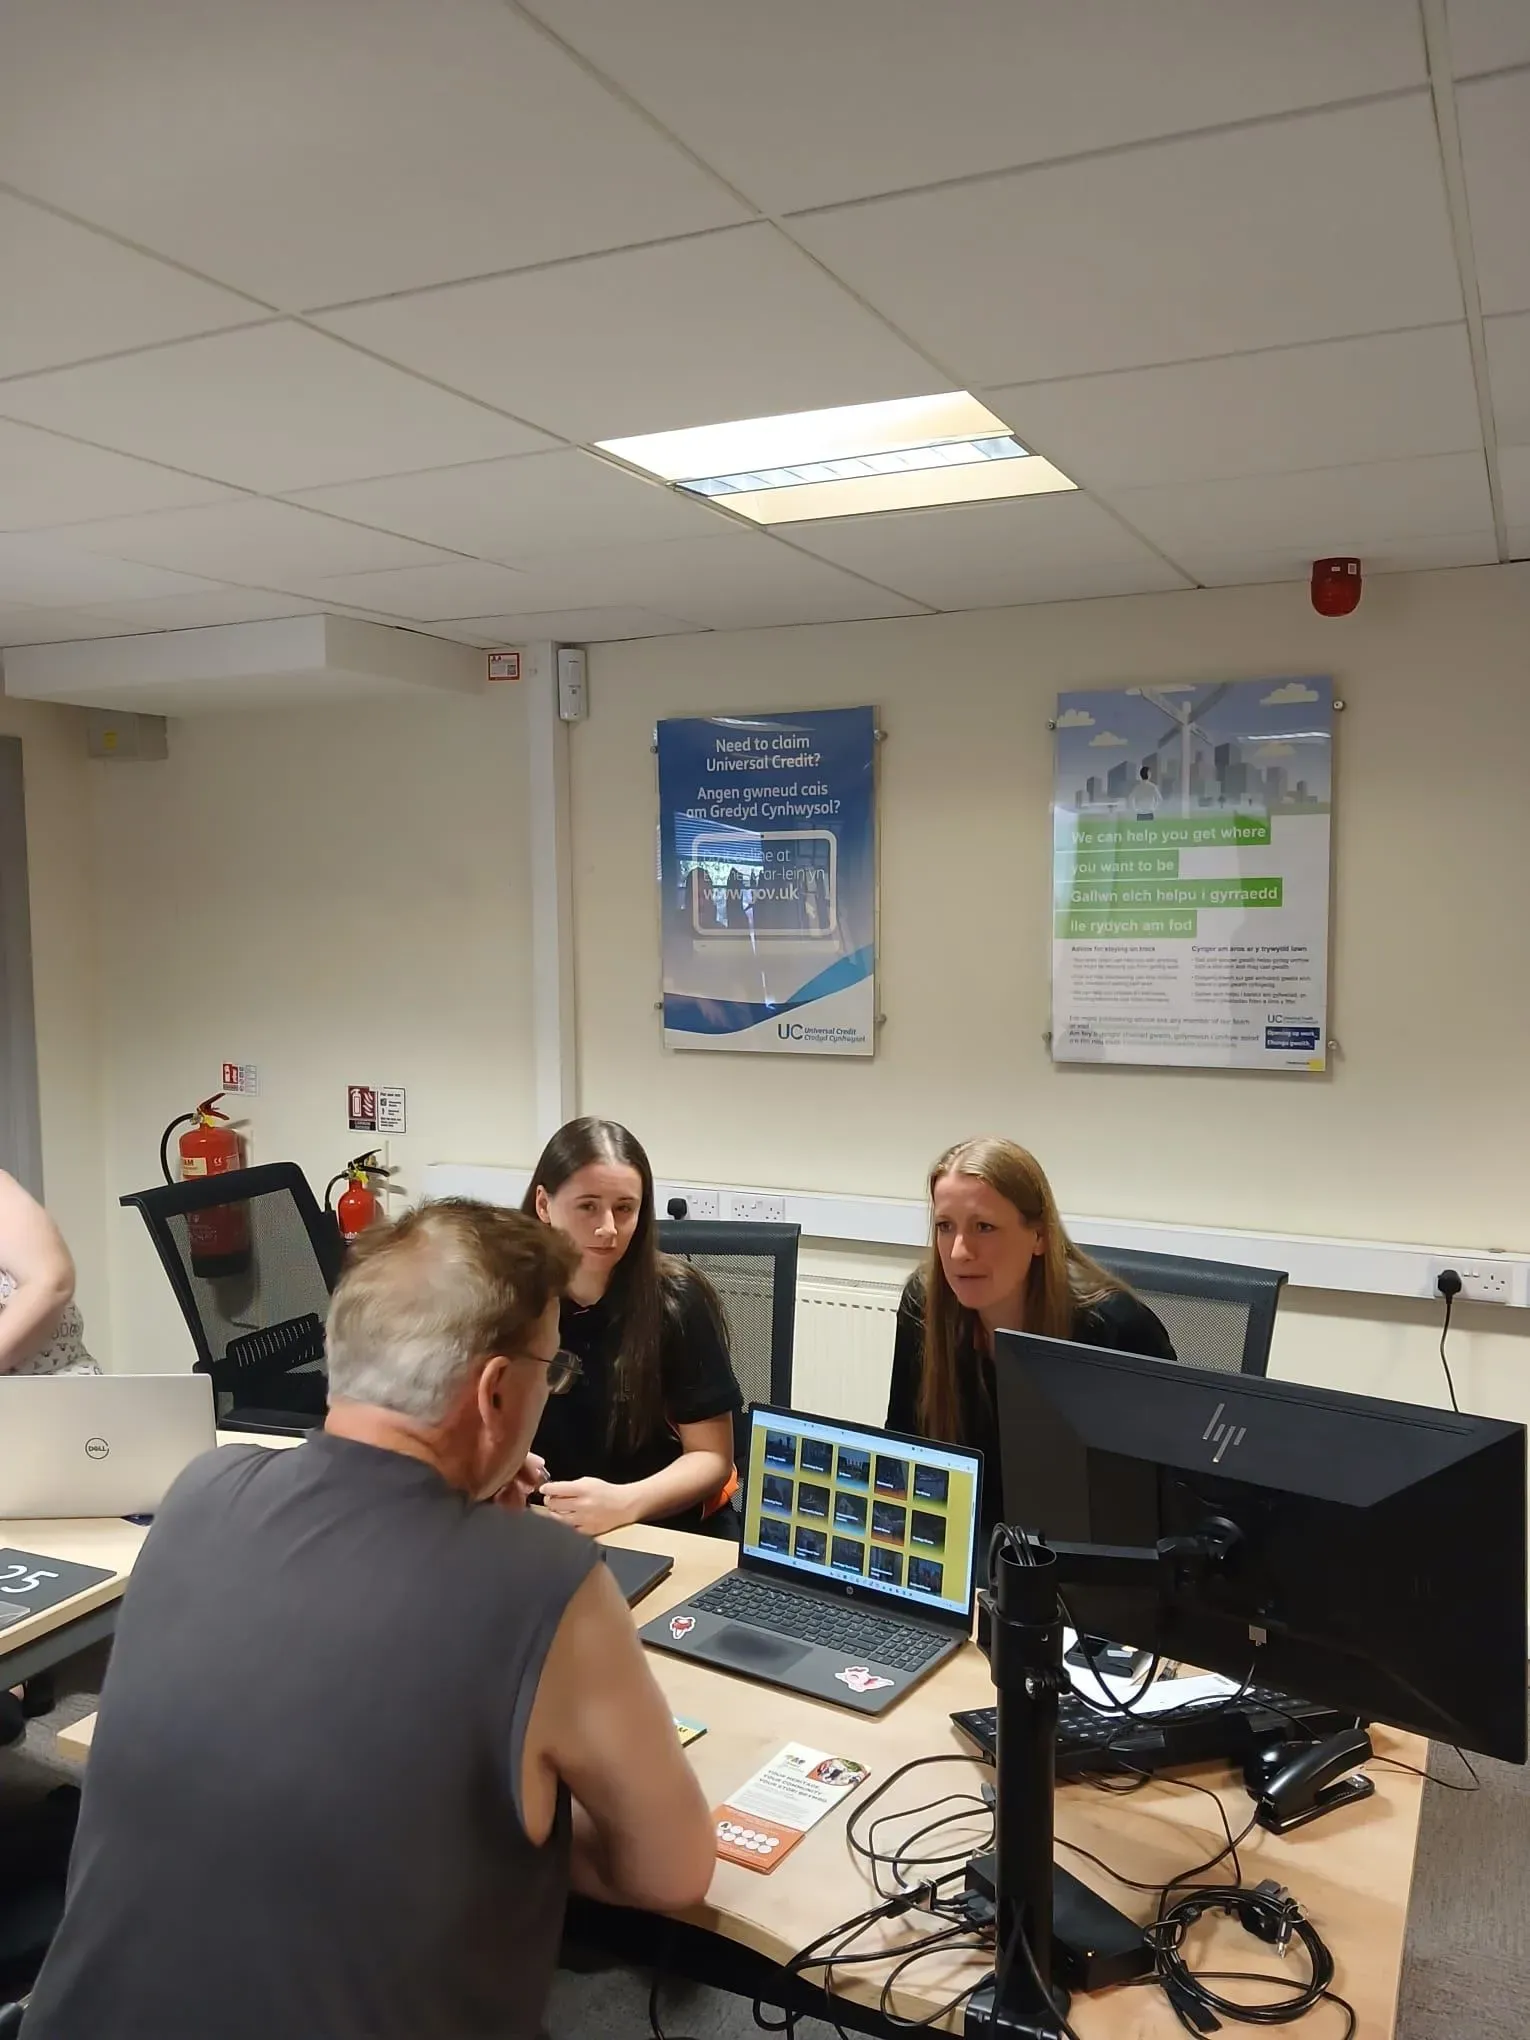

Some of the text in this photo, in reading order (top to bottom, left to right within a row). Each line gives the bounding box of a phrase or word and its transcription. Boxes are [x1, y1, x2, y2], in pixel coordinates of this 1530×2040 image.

[716, 734, 810, 753] Need to claim
[706, 753, 821, 772] Universal Credit?
[697, 781, 828, 803] Angen gwneud cais
[686, 800, 841, 823] am Gredyd Cynhwysol?
[1072, 827, 1266, 844] We can help you get where
[777, 850, 791, 862] at
[1072, 859, 1174, 876] you want to be
[1071, 890, 1118, 902] Gallwn
[1122, 890, 1152, 902] eich
[1156, 888, 1197, 903] helpu
[1210, 887, 1278, 903] gyrraedd
[1070, 919, 1192, 934] lle rydych am fod
[1268, 1014, 1283, 1024] UC
[778, 1024, 803, 1040] UC
[1202, 1403, 1246, 1463] hp
[0, 1565, 59, 1593] 25
